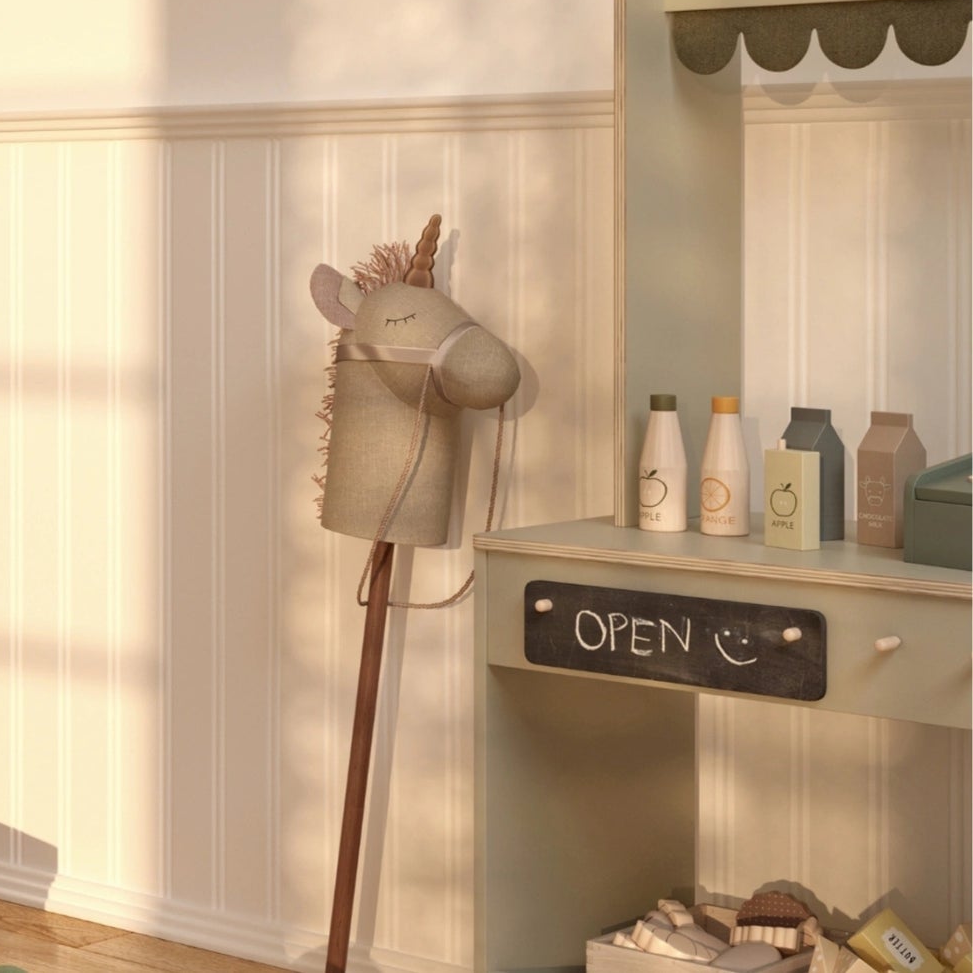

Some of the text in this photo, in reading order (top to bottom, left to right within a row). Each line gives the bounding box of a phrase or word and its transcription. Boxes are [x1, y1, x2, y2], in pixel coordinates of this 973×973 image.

[639, 511, 662, 522] PPLE
[771, 520, 795, 530] APPLE
[575, 609, 692, 657] OPEN
